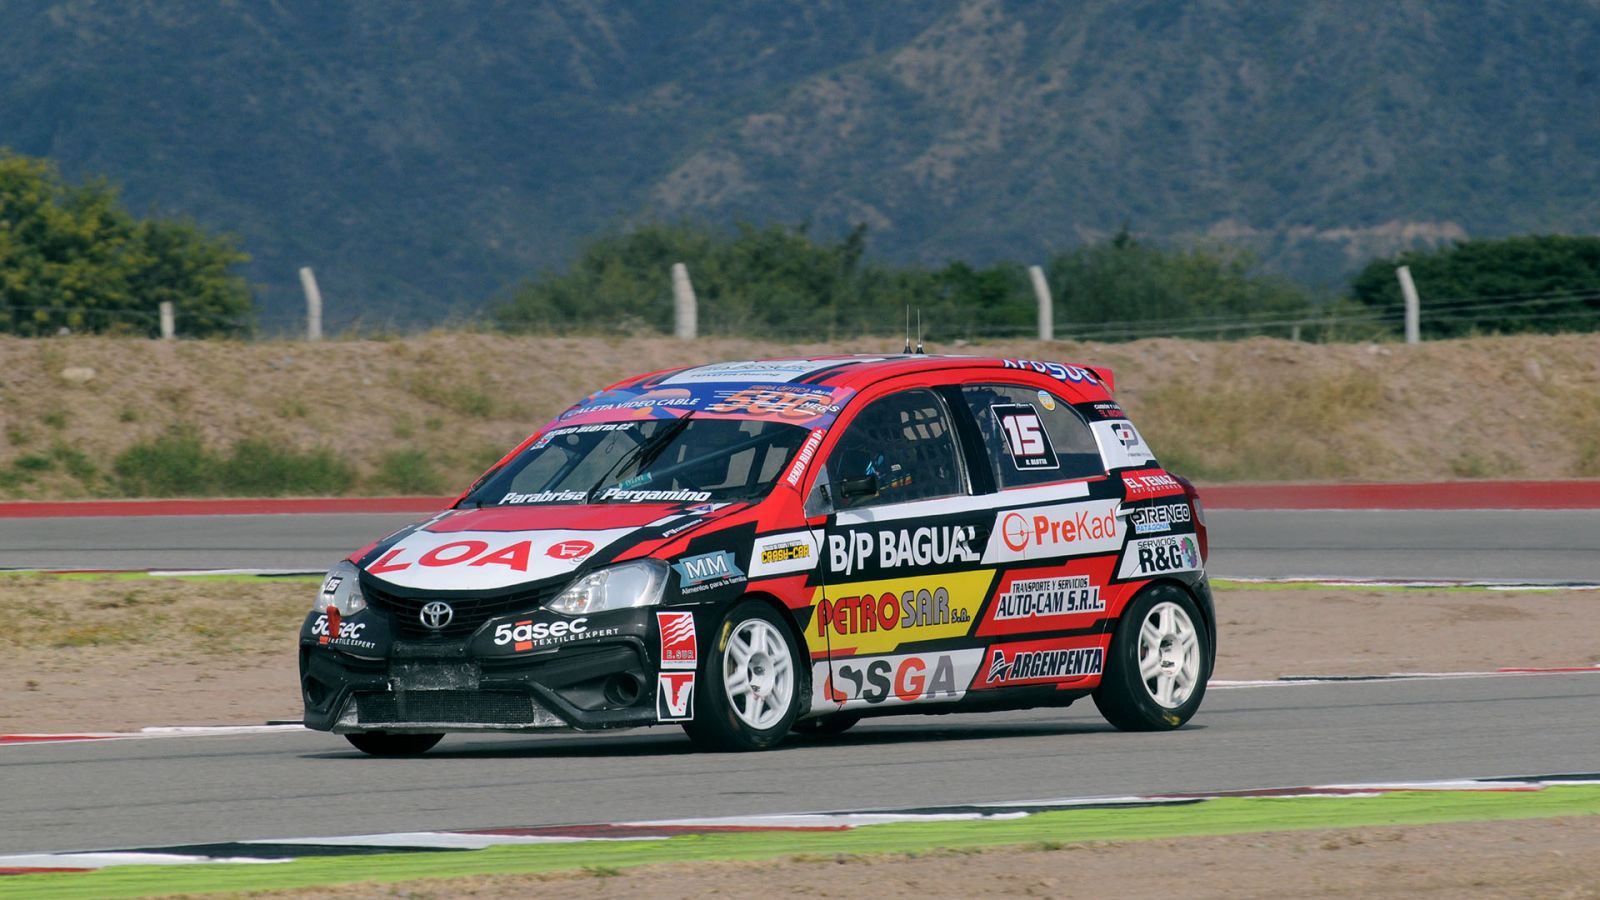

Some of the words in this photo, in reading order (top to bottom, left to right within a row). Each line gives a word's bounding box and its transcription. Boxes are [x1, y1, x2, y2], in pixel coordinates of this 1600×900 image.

[616, 400, 656, 410] VIDEO
[657, 398, 701, 406] CABLE
[1003, 415, 1046, 456] 15
[799, 438, 820, 465] BLOTTA
[1122, 478, 1143, 489] EL
[1138, 475, 1178, 487] TENAZ
[498, 489, 588, 505] Parabrisa
[600, 488, 713, 503] Pergamino
[1033, 508, 1116, 545] PreKad
[1136, 522, 1171, 532] PATAGONIA
[761, 544, 810, 564] CRASH-CAR
[828, 529, 874, 576] B/P
[879, 525, 981, 569] BAGUAL
[1137, 537, 1177, 550] SERVICIOS
[367, 540, 532, 575] LOA
[684, 554, 729, 579] MM
[1138, 544, 1184, 574] R&G
[325, 578, 341, 592] 15
[681, 584, 710, 595] Alimentos
[710, 581, 724, 590] para
[729, 576, 747, 584] familia
[1012, 581, 1051, 594] TRANSPORTE
[1052, 580, 1057, 590] Y
[1058, 578, 1088, 591] SERVICIOS
[816, 586, 950, 638] PETROSAR
[996, 590, 1064, 617] AUTO-CAM
[1067, 588, 1104, 611] S.R.L.
[493, 617, 589, 646] 5asec
[533, 635, 575, 647] TEXTILE
[578, 627, 620, 640] EXPERT
[350, 639, 376, 650] EXPERT
[1010, 648, 1102, 679] ARGENPENTA
